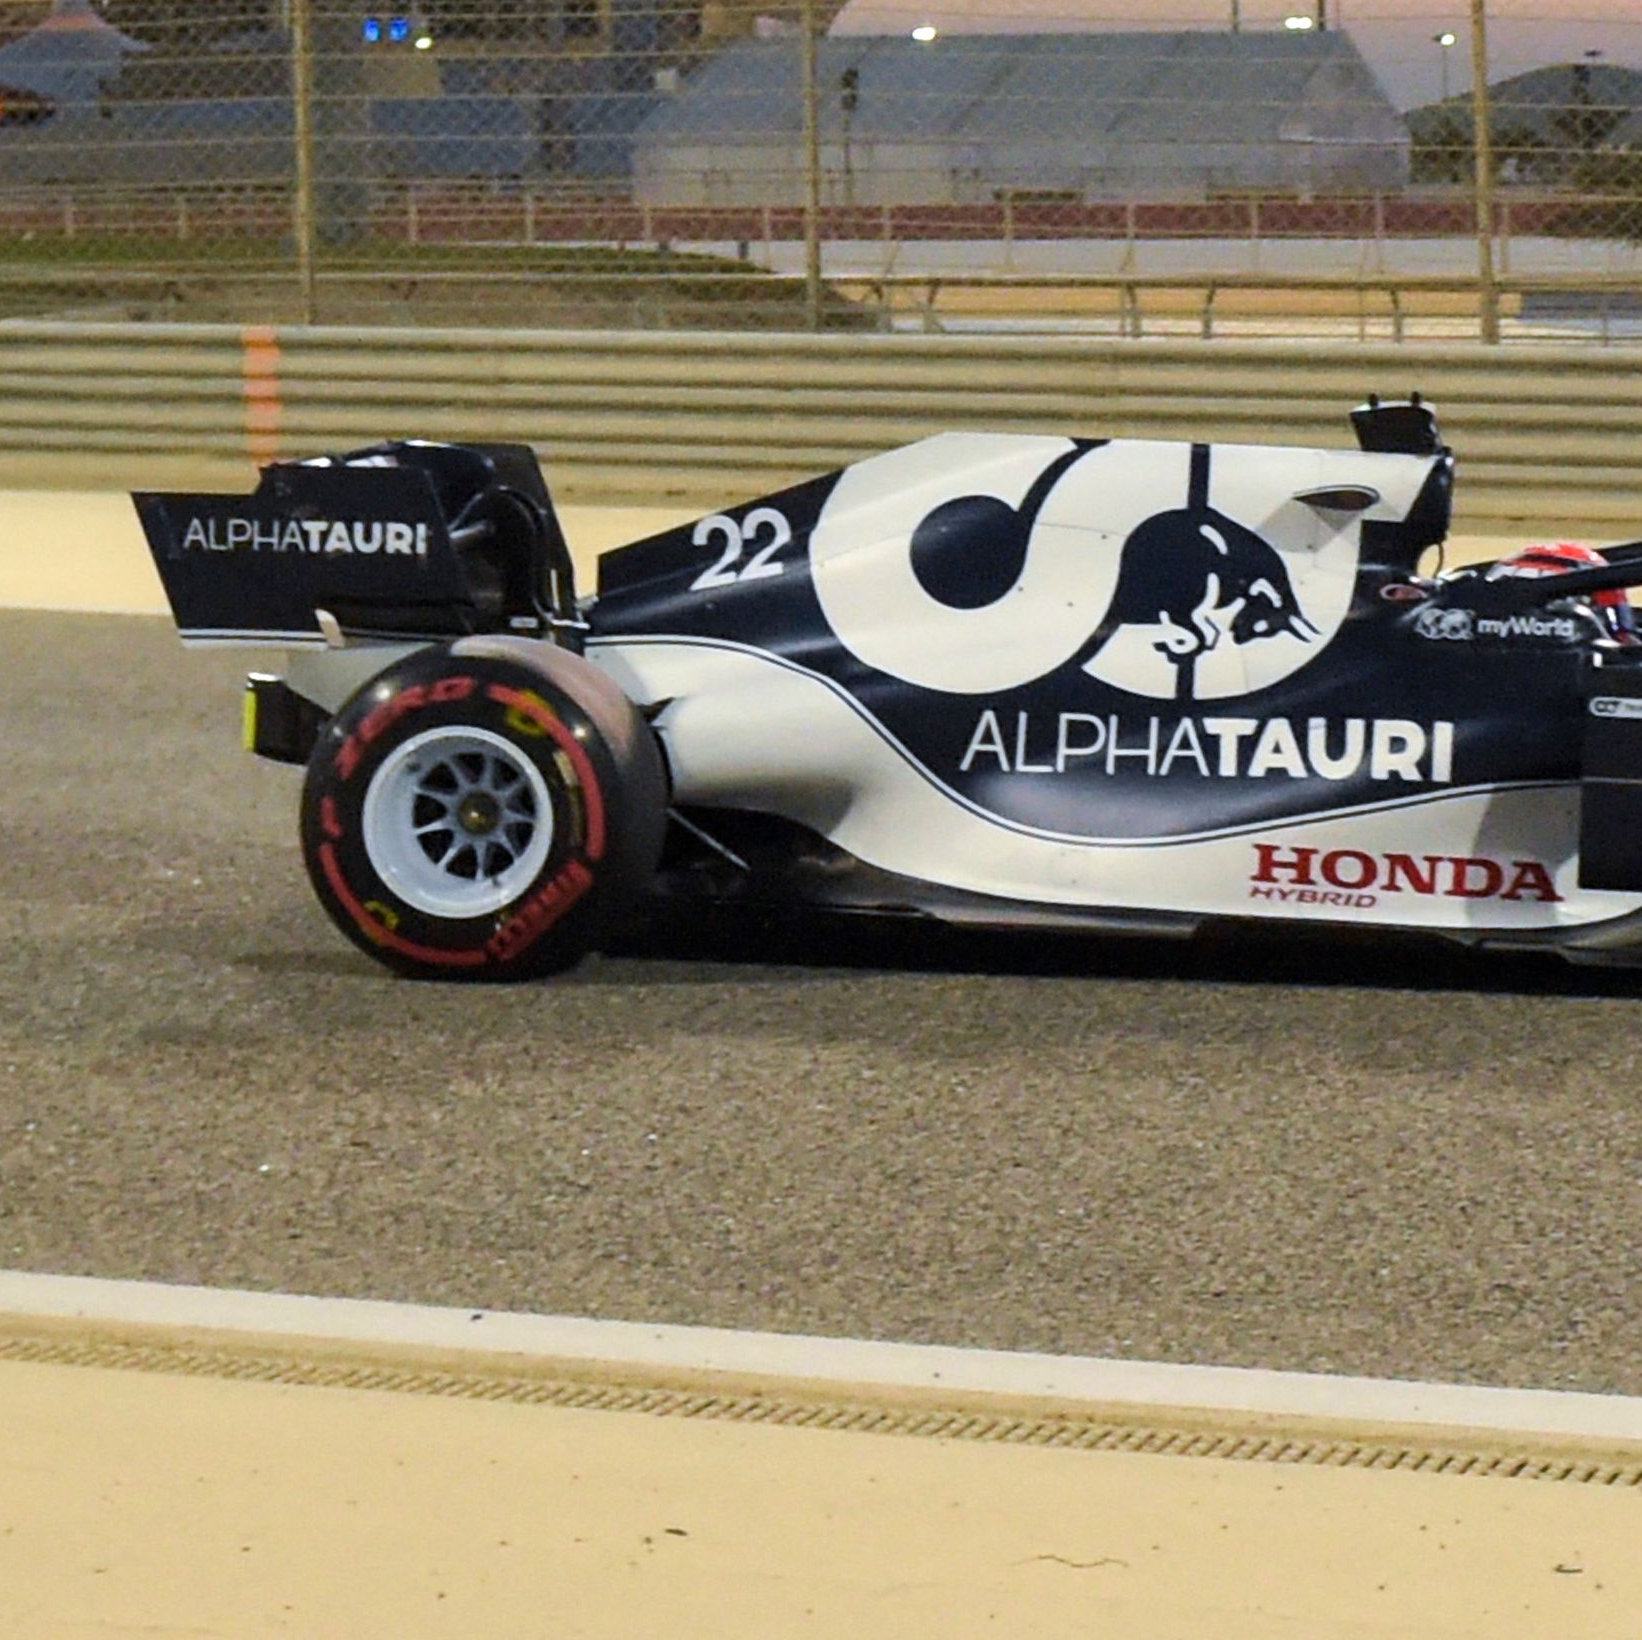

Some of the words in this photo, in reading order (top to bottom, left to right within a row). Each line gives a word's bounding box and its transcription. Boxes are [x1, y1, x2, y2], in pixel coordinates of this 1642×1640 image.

[183, 517, 427, 555] ALPHATAURI
[689, 507, 791, 591] 22
[1477, 616, 1574, 638] myWorld
[960, 709, 1455, 783] ALPHATAURI
[1250, 843, 1564, 902] HONDA
[1249, 886, 1377, 909] HYBRID
